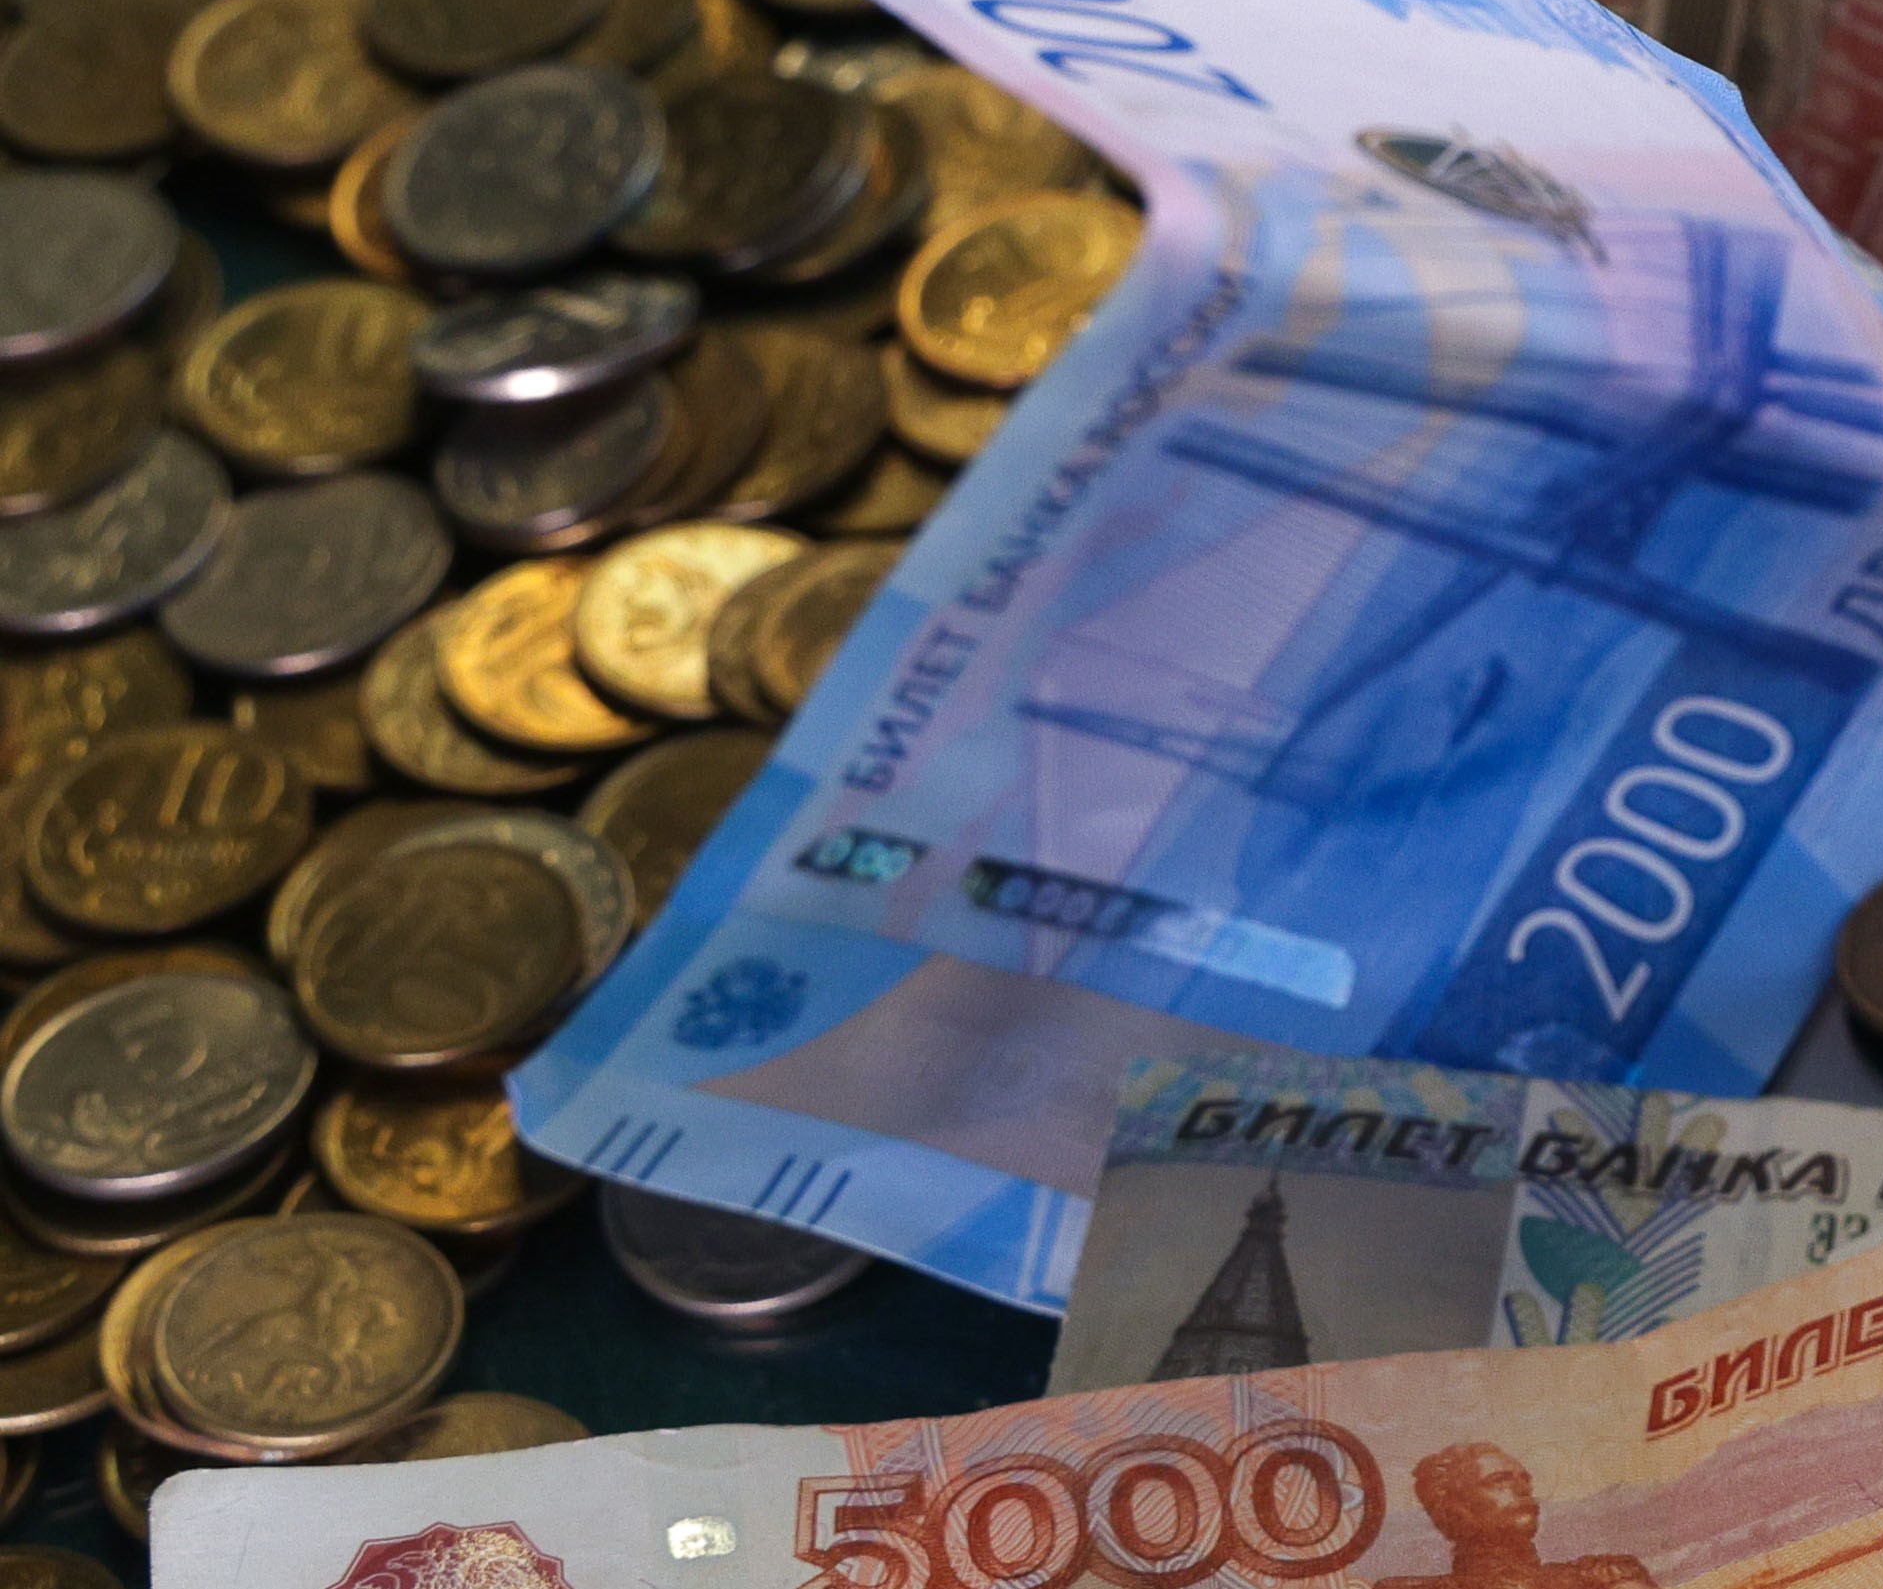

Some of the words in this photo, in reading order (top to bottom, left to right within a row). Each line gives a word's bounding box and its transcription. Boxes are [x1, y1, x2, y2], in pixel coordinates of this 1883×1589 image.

[844, 628, 986, 796] БИЛЕТ
[1508, 695, 1793, 1024] 2000
[1173, 1096, 1497, 1169] БИЛЕТ
[1516, 1132, 1847, 1203] БАНКА
[794, 1418, 1387, 1589] 5000
